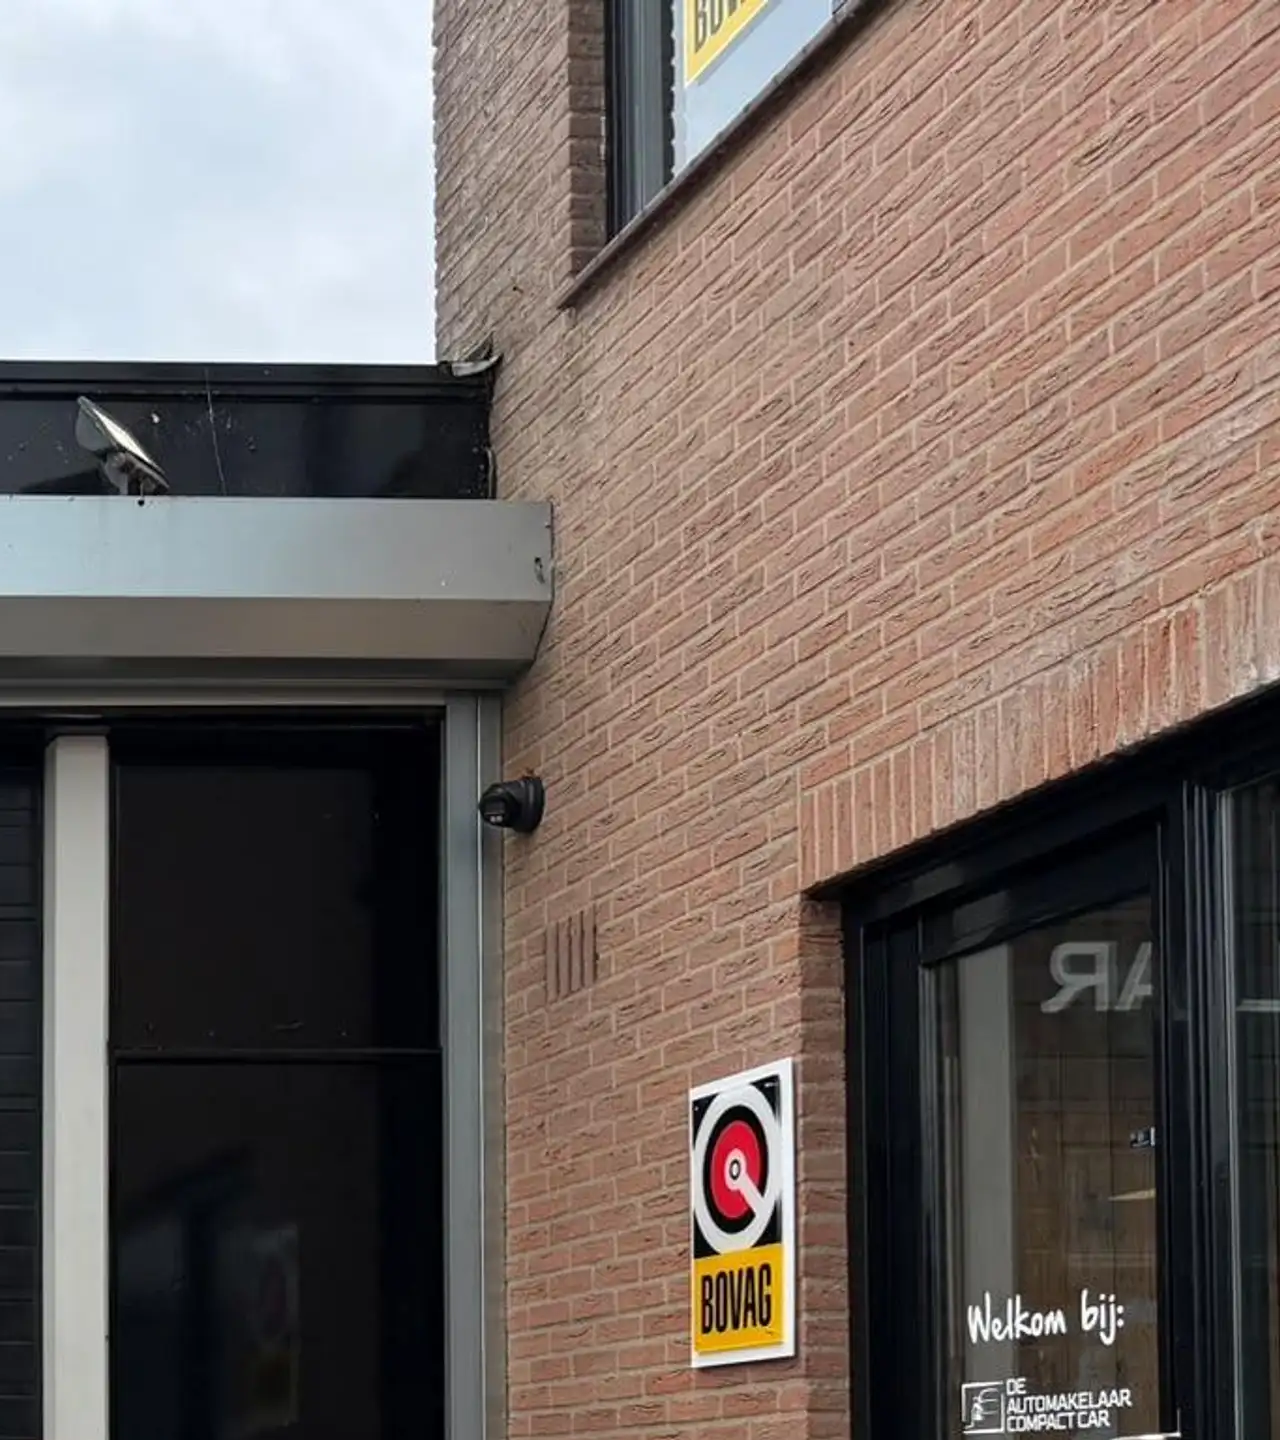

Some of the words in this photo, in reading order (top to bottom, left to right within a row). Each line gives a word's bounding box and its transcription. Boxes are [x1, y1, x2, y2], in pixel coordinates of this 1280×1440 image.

[701, 1263, 773, 1335] BOVAG
[967, 1291, 1067, 1344] Welkom
[1081, 1288, 1125, 1346] bij:
[1006, 1378, 1027, 1396] DE
[1006, 1388, 1133, 1415] AUTOMAKELAAR
[1006, 1411, 1076, 1433] COMPACT
[1077, 1409, 1111, 1429] CAR
